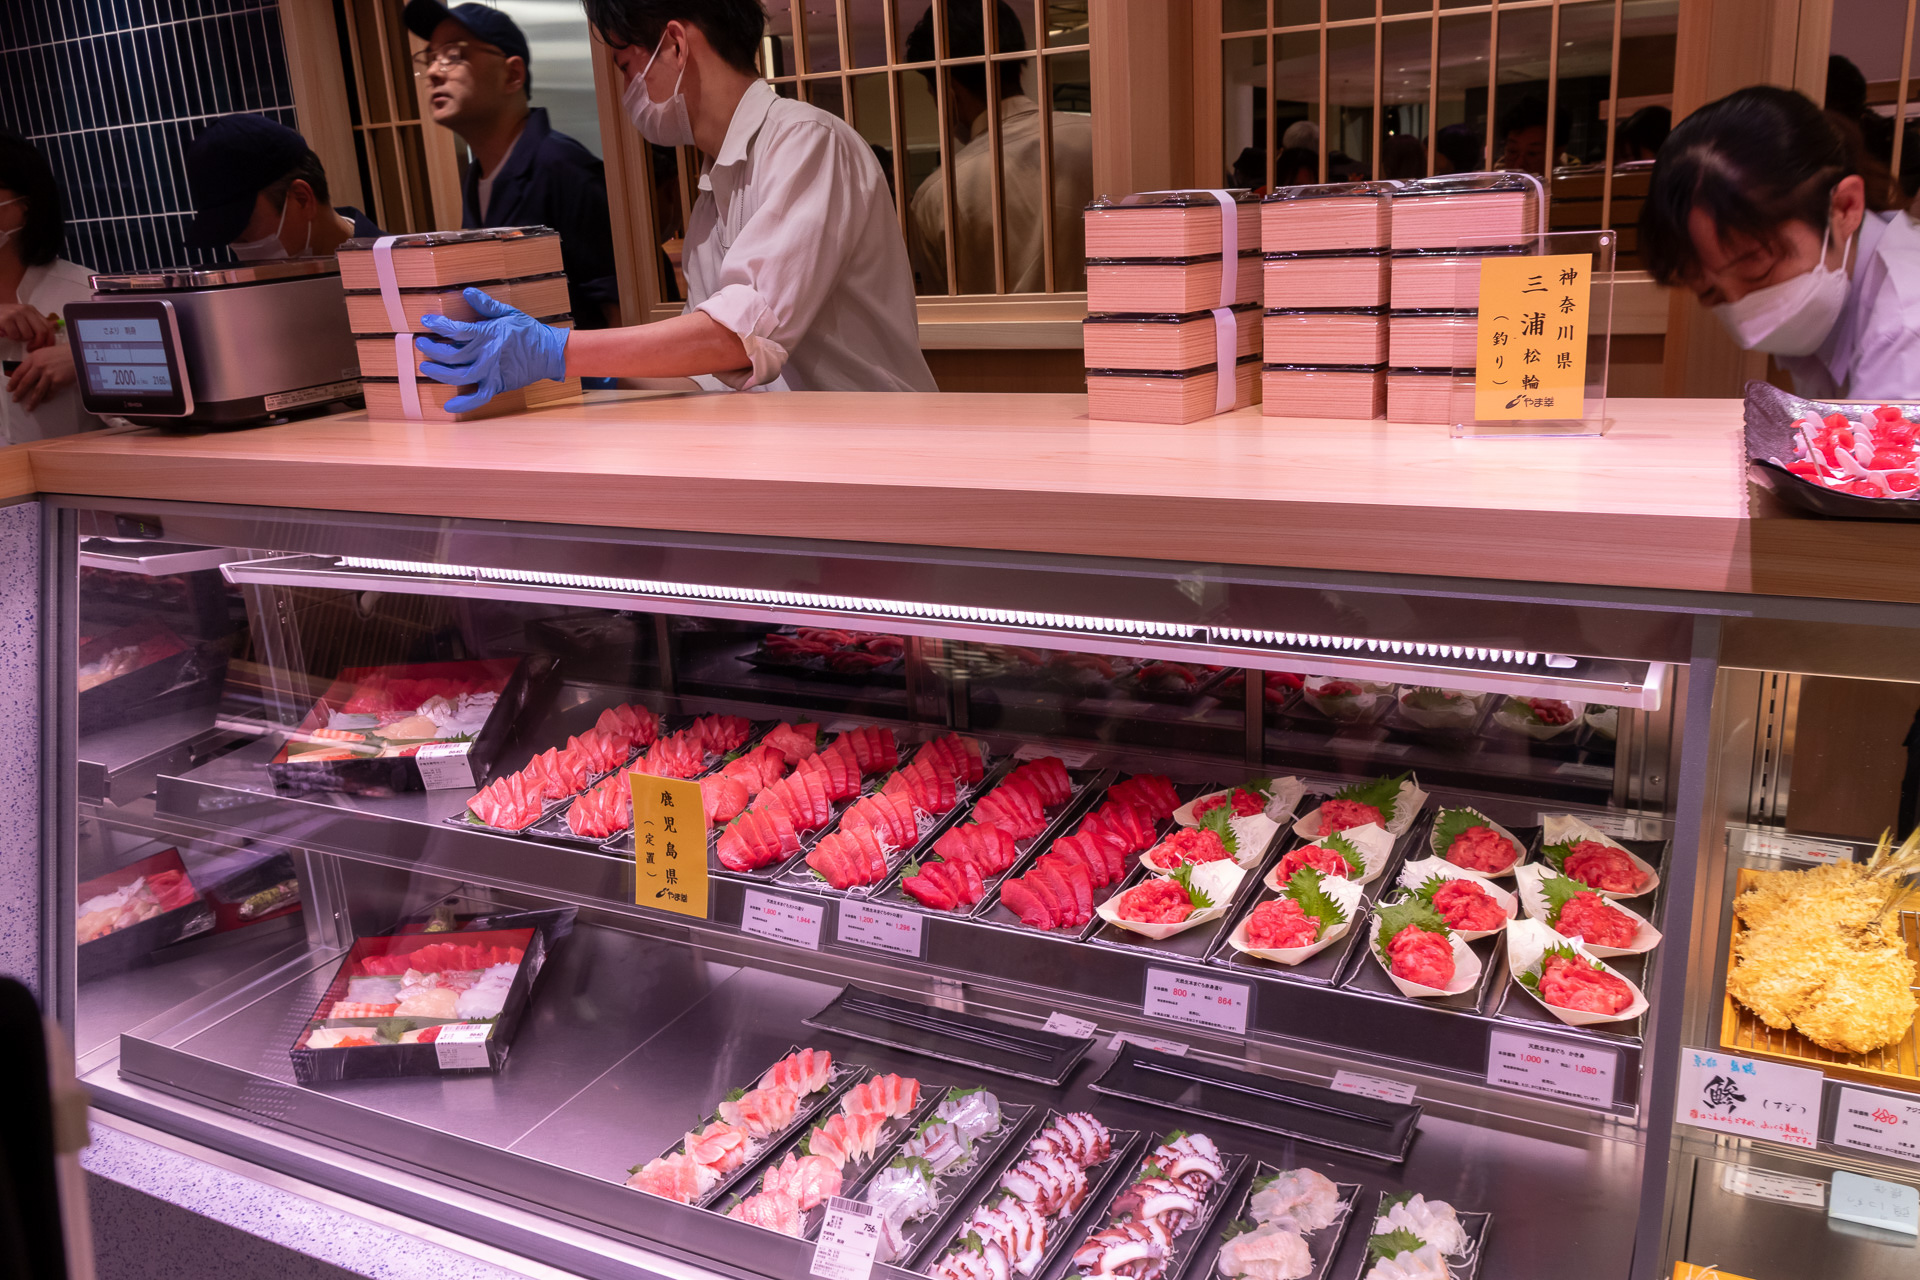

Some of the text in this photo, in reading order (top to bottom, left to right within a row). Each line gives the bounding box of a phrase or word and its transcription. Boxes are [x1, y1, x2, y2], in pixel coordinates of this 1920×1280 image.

[1557, 268, 1578, 369] 神奈川県
[1521, 275, 1549, 390] 三浦松輪
[112, 370, 136, 385] 2000
[661, 791, 678, 885] 鹿児島県
[763, 907, 777, 916] 1,800
[859, 915, 874, 925] 1,200
[895, 923, 911, 932] 1,296
[1172, 988, 1187, 997] 800
[1217, 997, 1232, 1006] 864
[1528, 1043, 1565, 1055] 天然生本まぐろ
[1520, 1053, 1542, 1064] 1,000
[1575, 1064, 1597, 1075] 1,080
[1872, 1108, 1898, 1125] 480
[864, 1223, 875, 1233] 756
